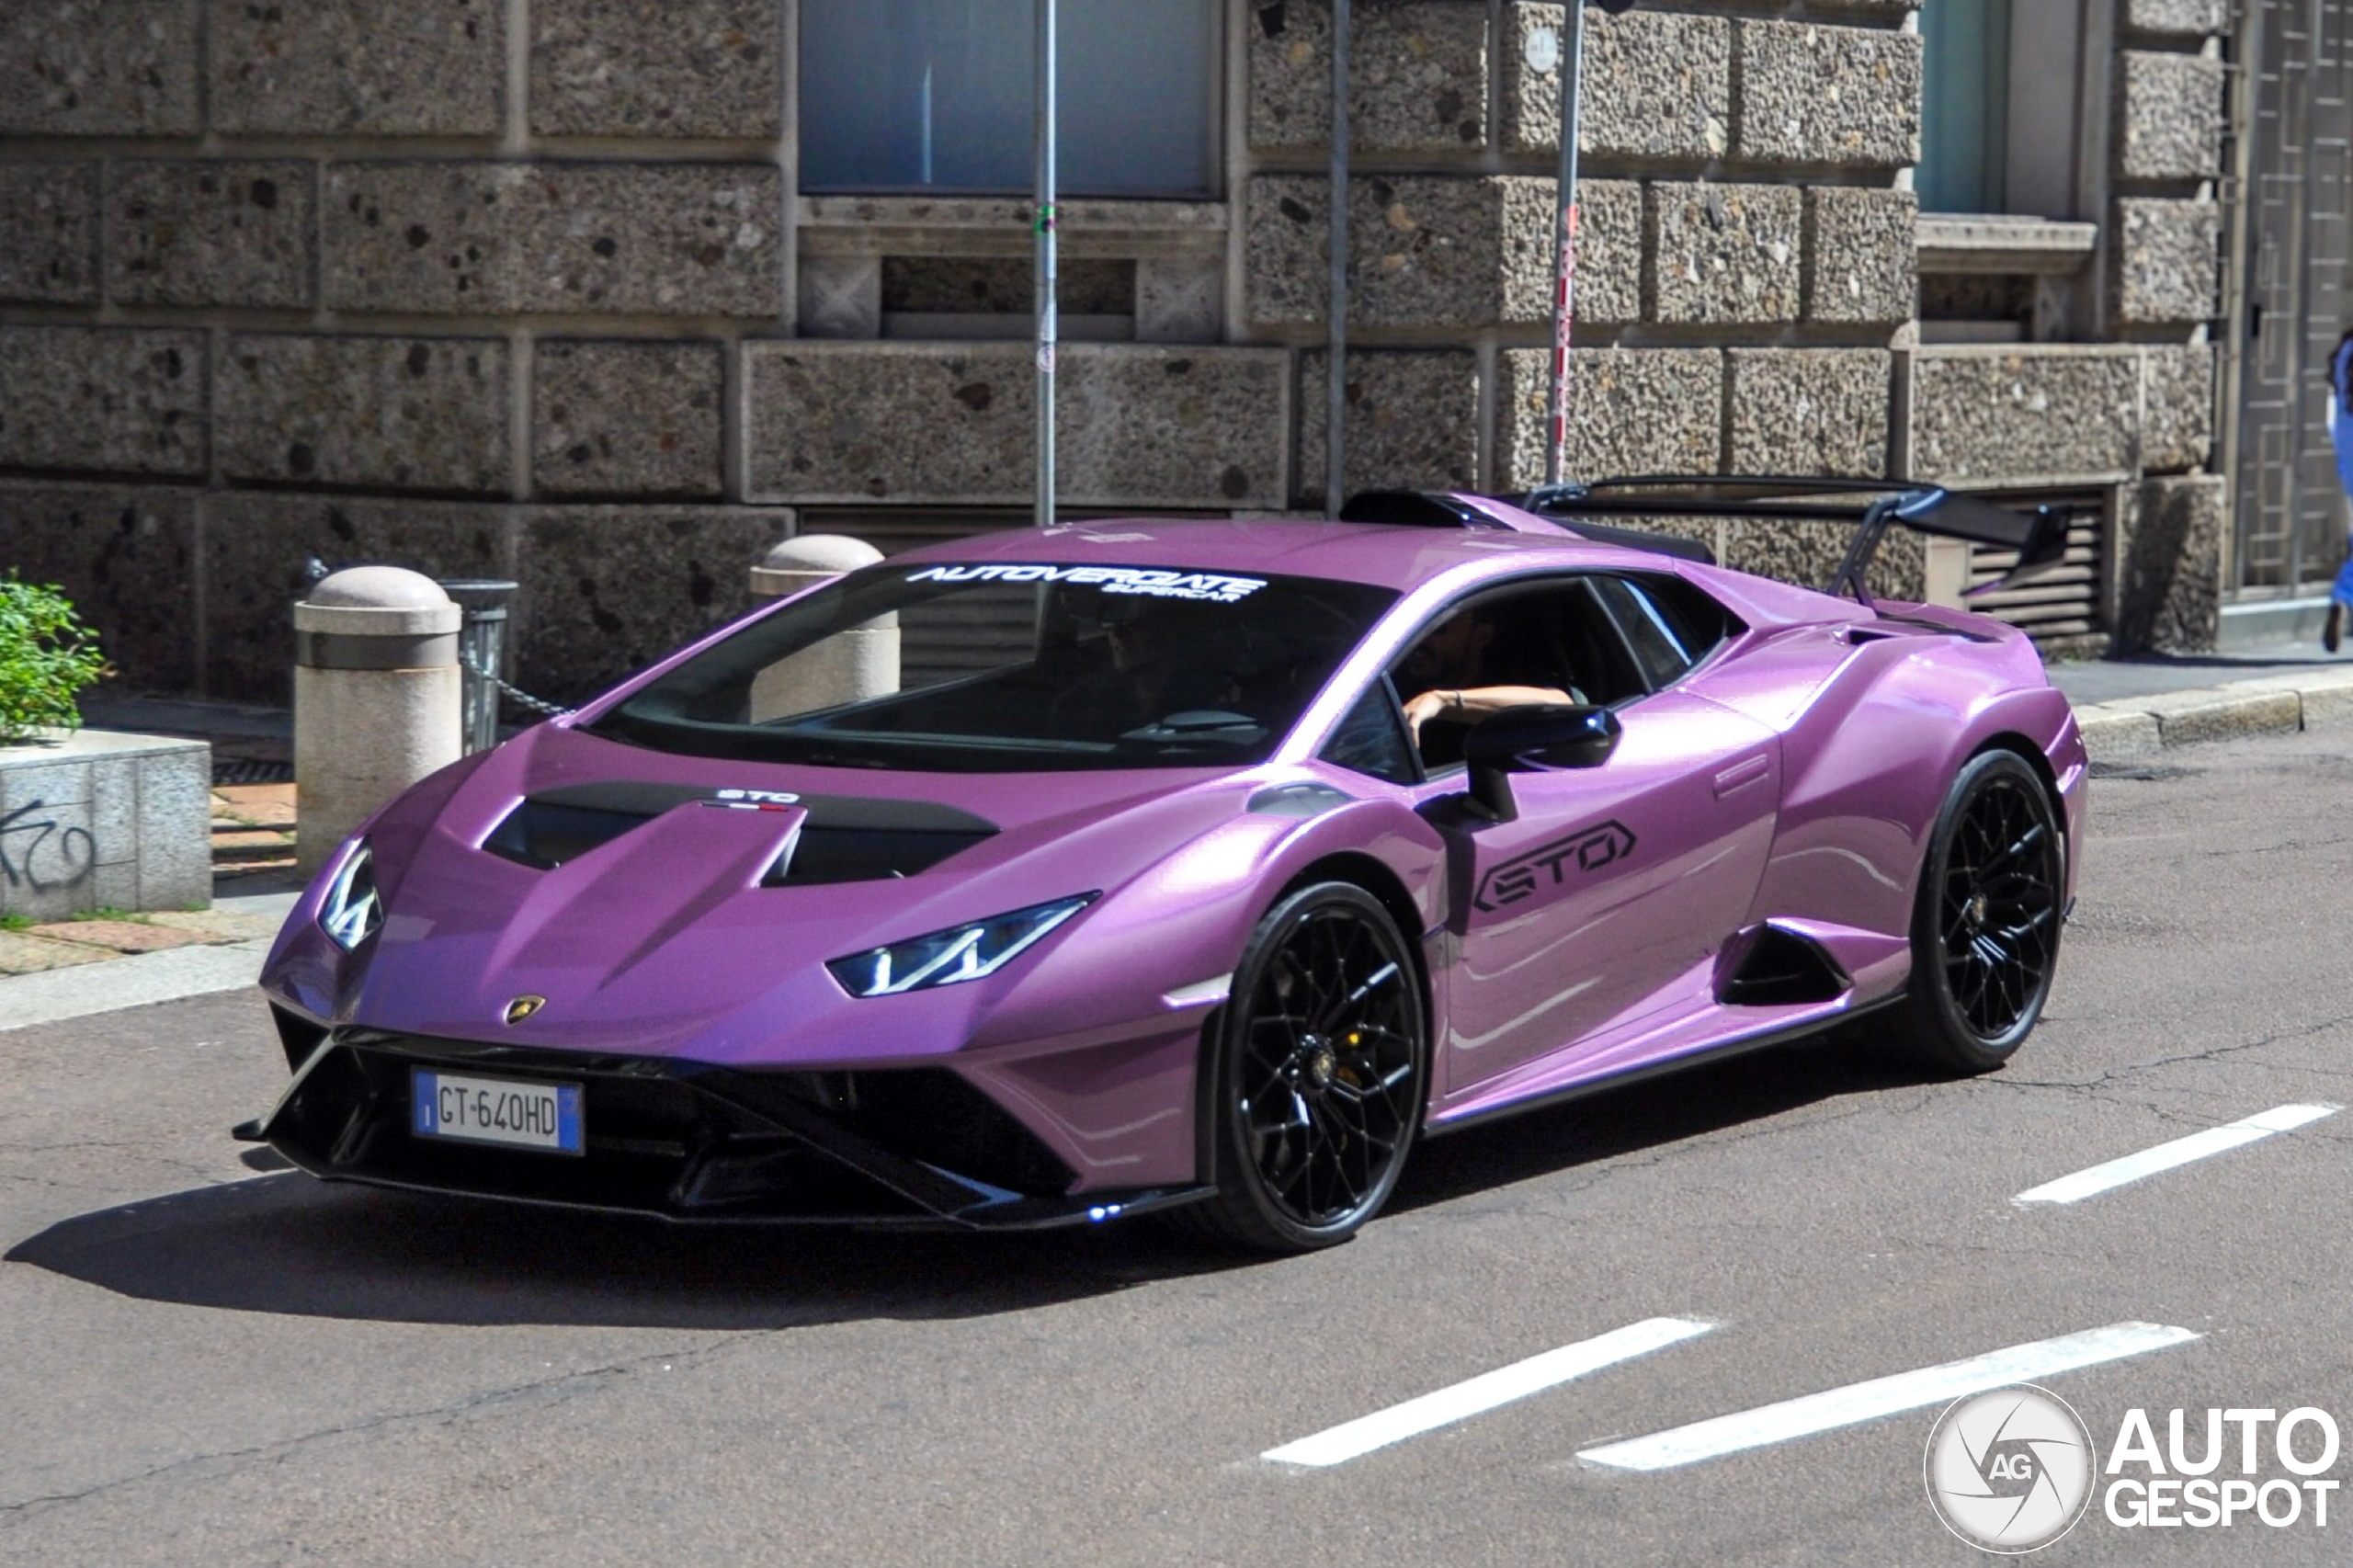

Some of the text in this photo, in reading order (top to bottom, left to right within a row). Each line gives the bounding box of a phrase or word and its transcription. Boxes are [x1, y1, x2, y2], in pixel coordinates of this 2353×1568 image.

[906, 566, 1268, 595] AUTOVERGIATE
[1101, 583, 1242, 603] SUPERCAR
[717, 789, 800, 803] STO
[1494, 834, 1617, 904] STO
